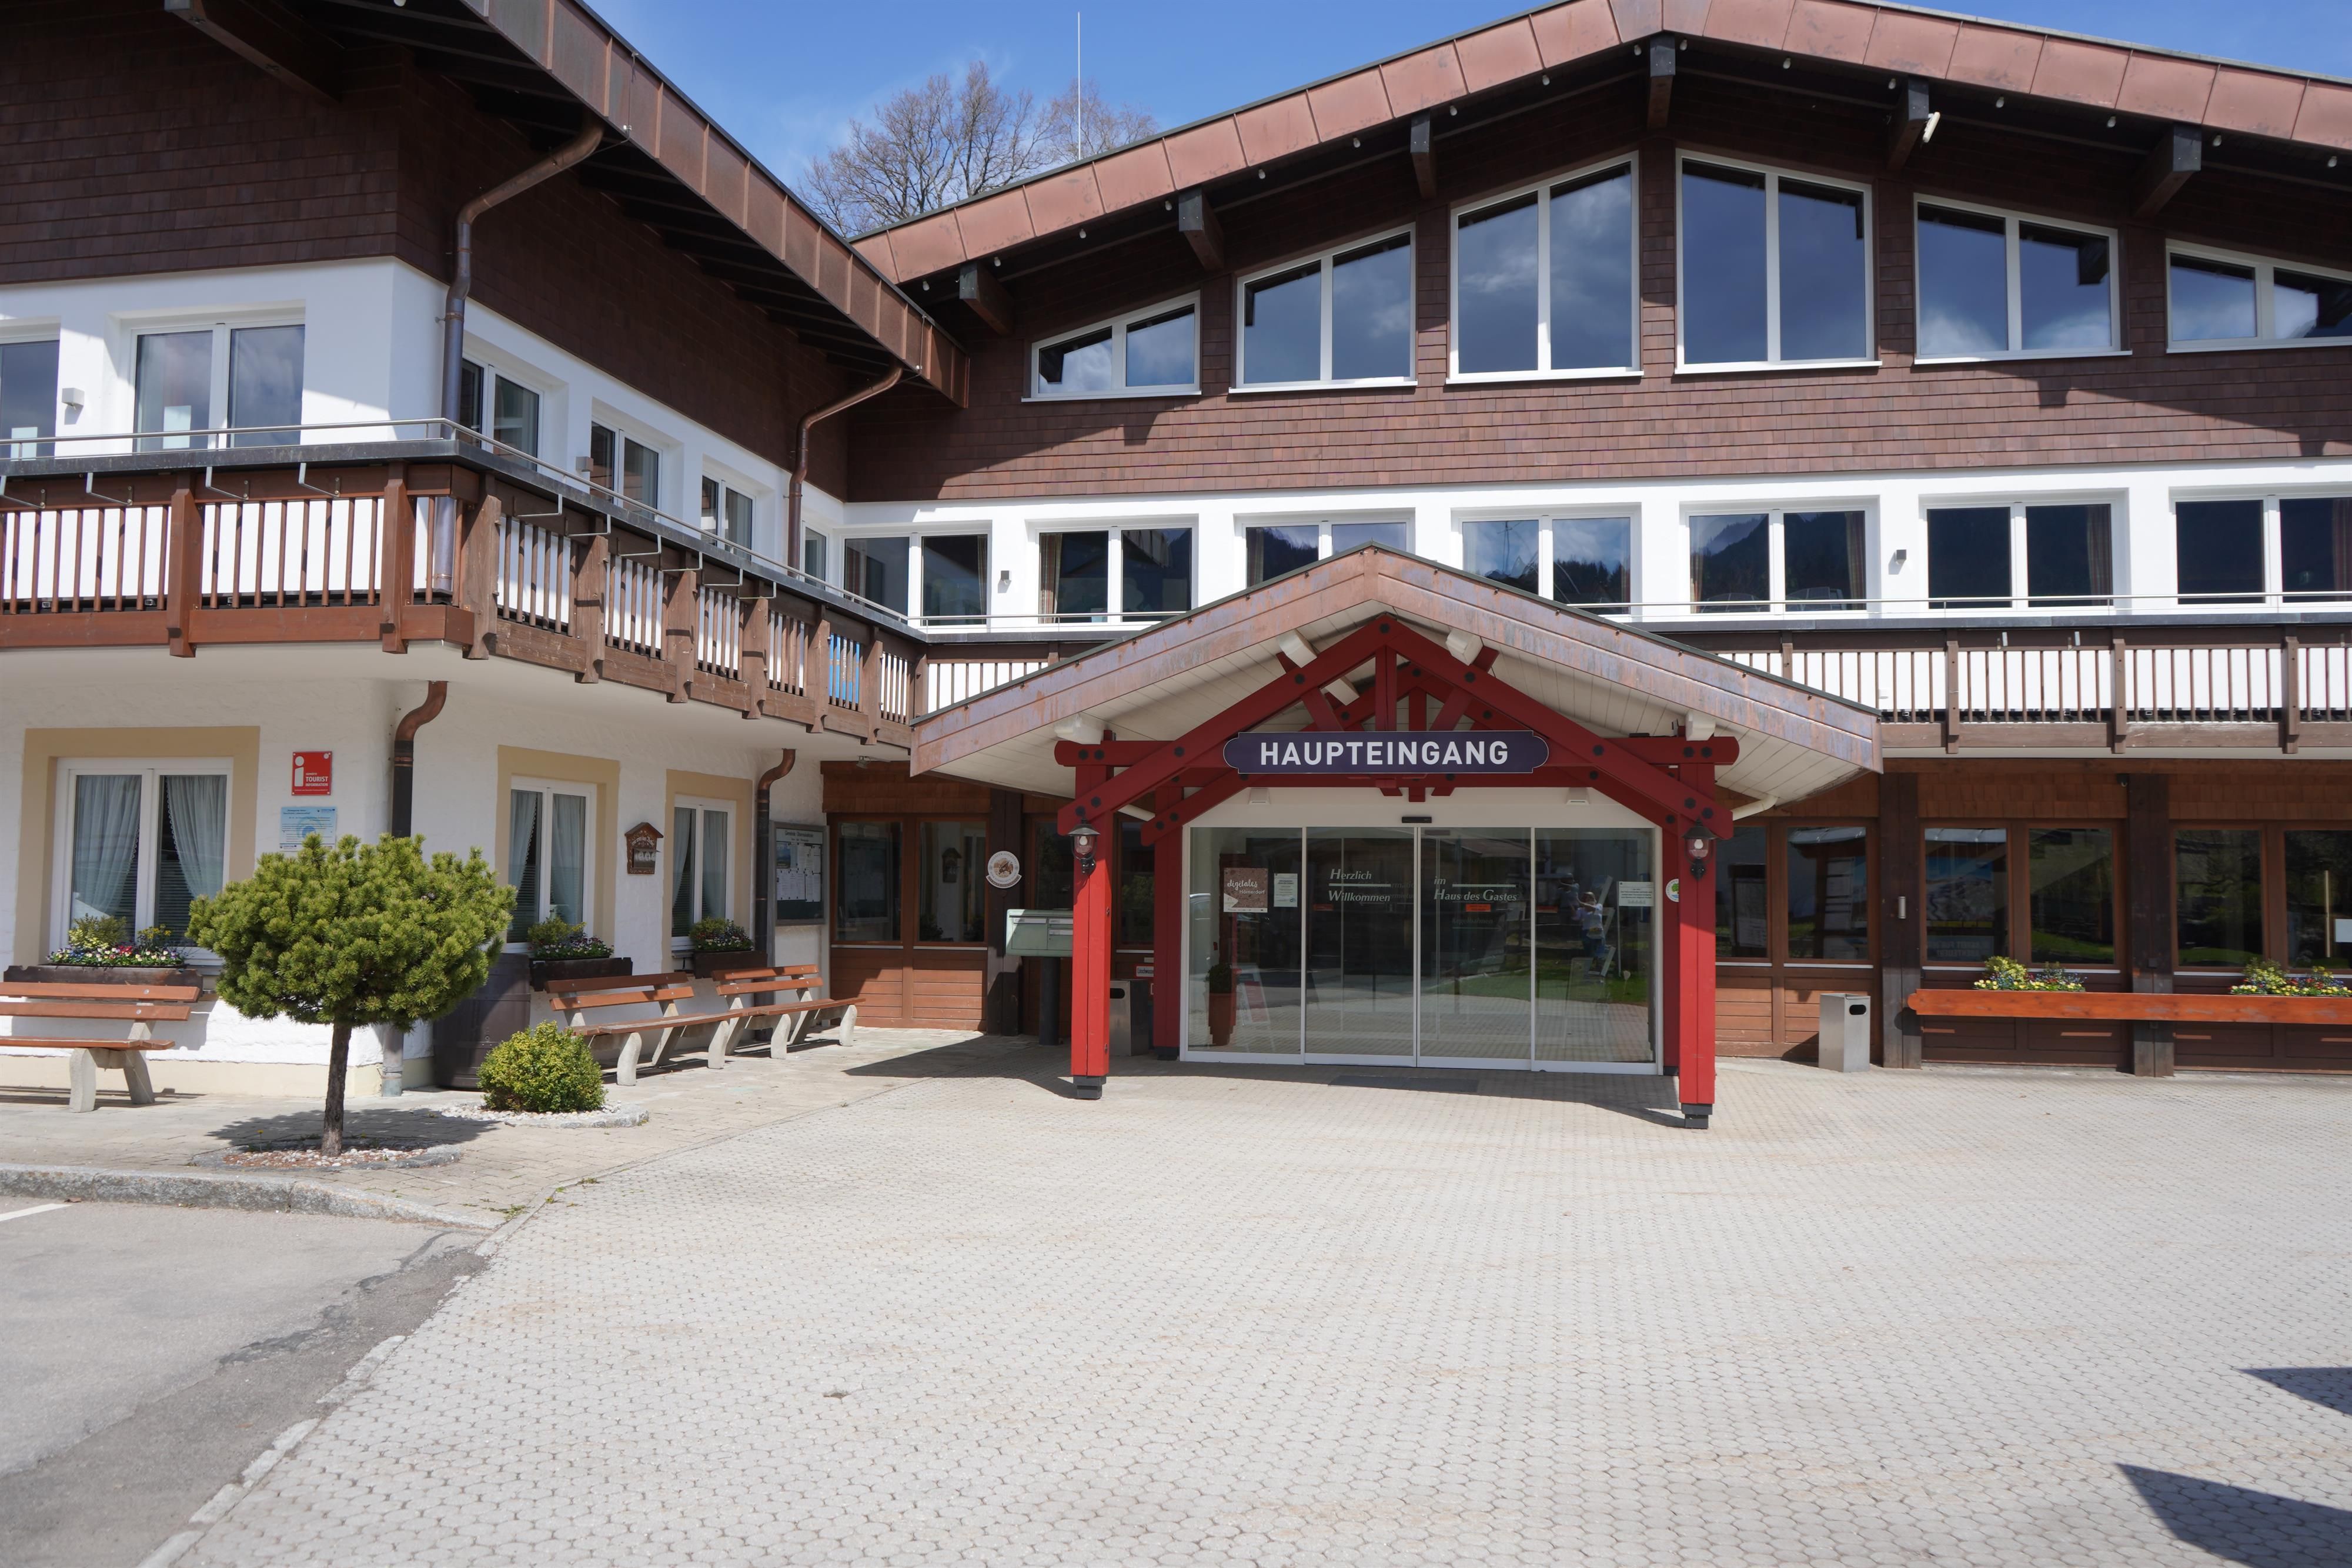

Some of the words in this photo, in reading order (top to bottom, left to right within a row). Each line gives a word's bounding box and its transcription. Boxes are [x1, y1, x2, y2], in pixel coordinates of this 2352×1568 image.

[1261, 740, 1508, 765] HAUPTEINGANG
[1330, 868, 1372, 880] Herzlich
[1227, 879, 1258, 891] digitales
[1434, 876, 1446, 885] im
[1328, 890, 1390, 901] Willkommen
[1434, 888, 1461, 900] Haus
[1464, 891, 1480, 901] des
[1483, 889, 1517, 901] Gastes
